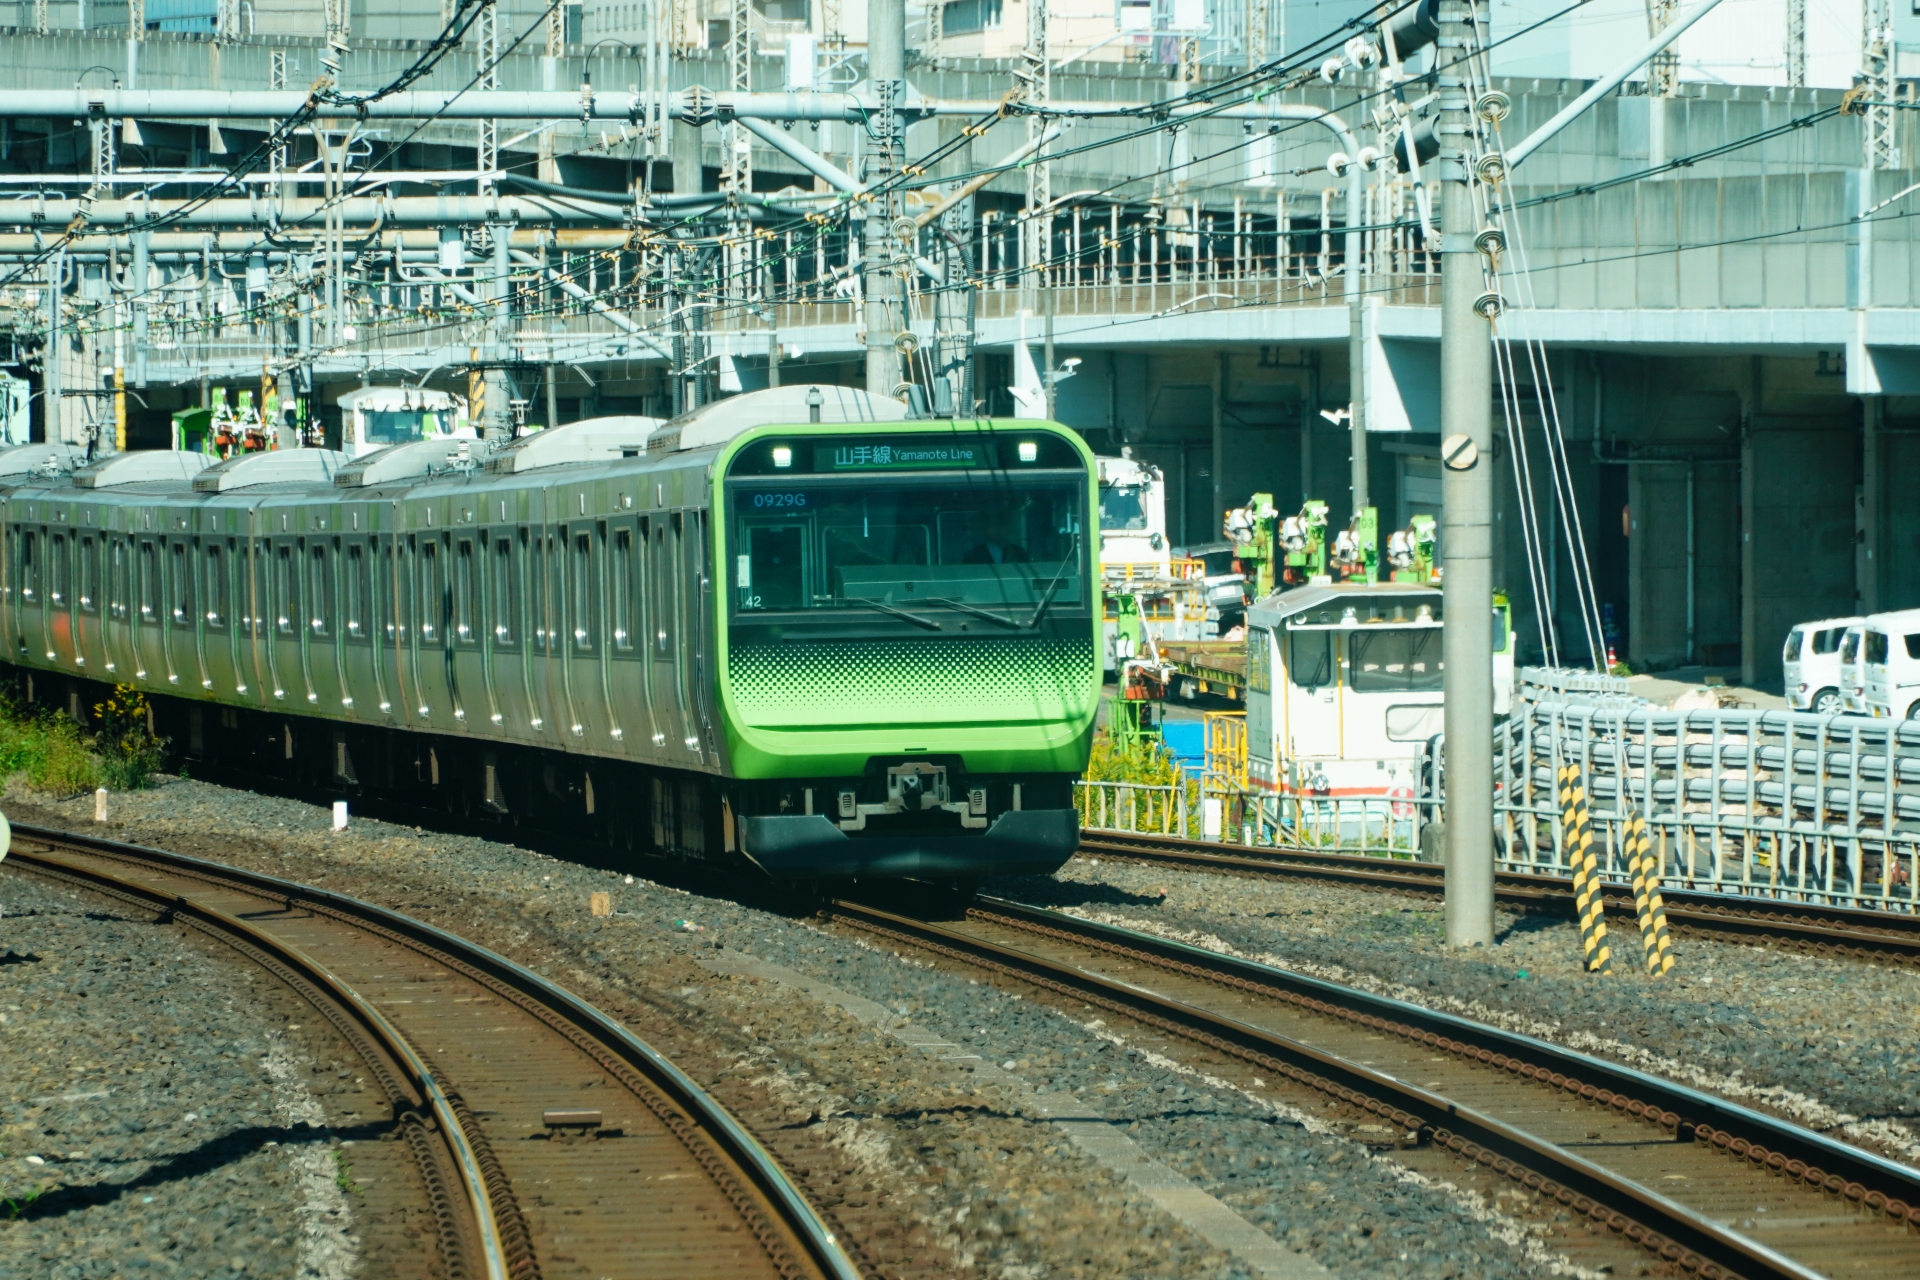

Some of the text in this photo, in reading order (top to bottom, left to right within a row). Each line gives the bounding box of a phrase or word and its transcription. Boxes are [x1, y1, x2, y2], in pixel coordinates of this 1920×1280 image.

[835, 445, 973, 465] 山手線 Yamanote Line
[754, 493, 806, 507] 0929G
[745, 595, 762, 608] 42
